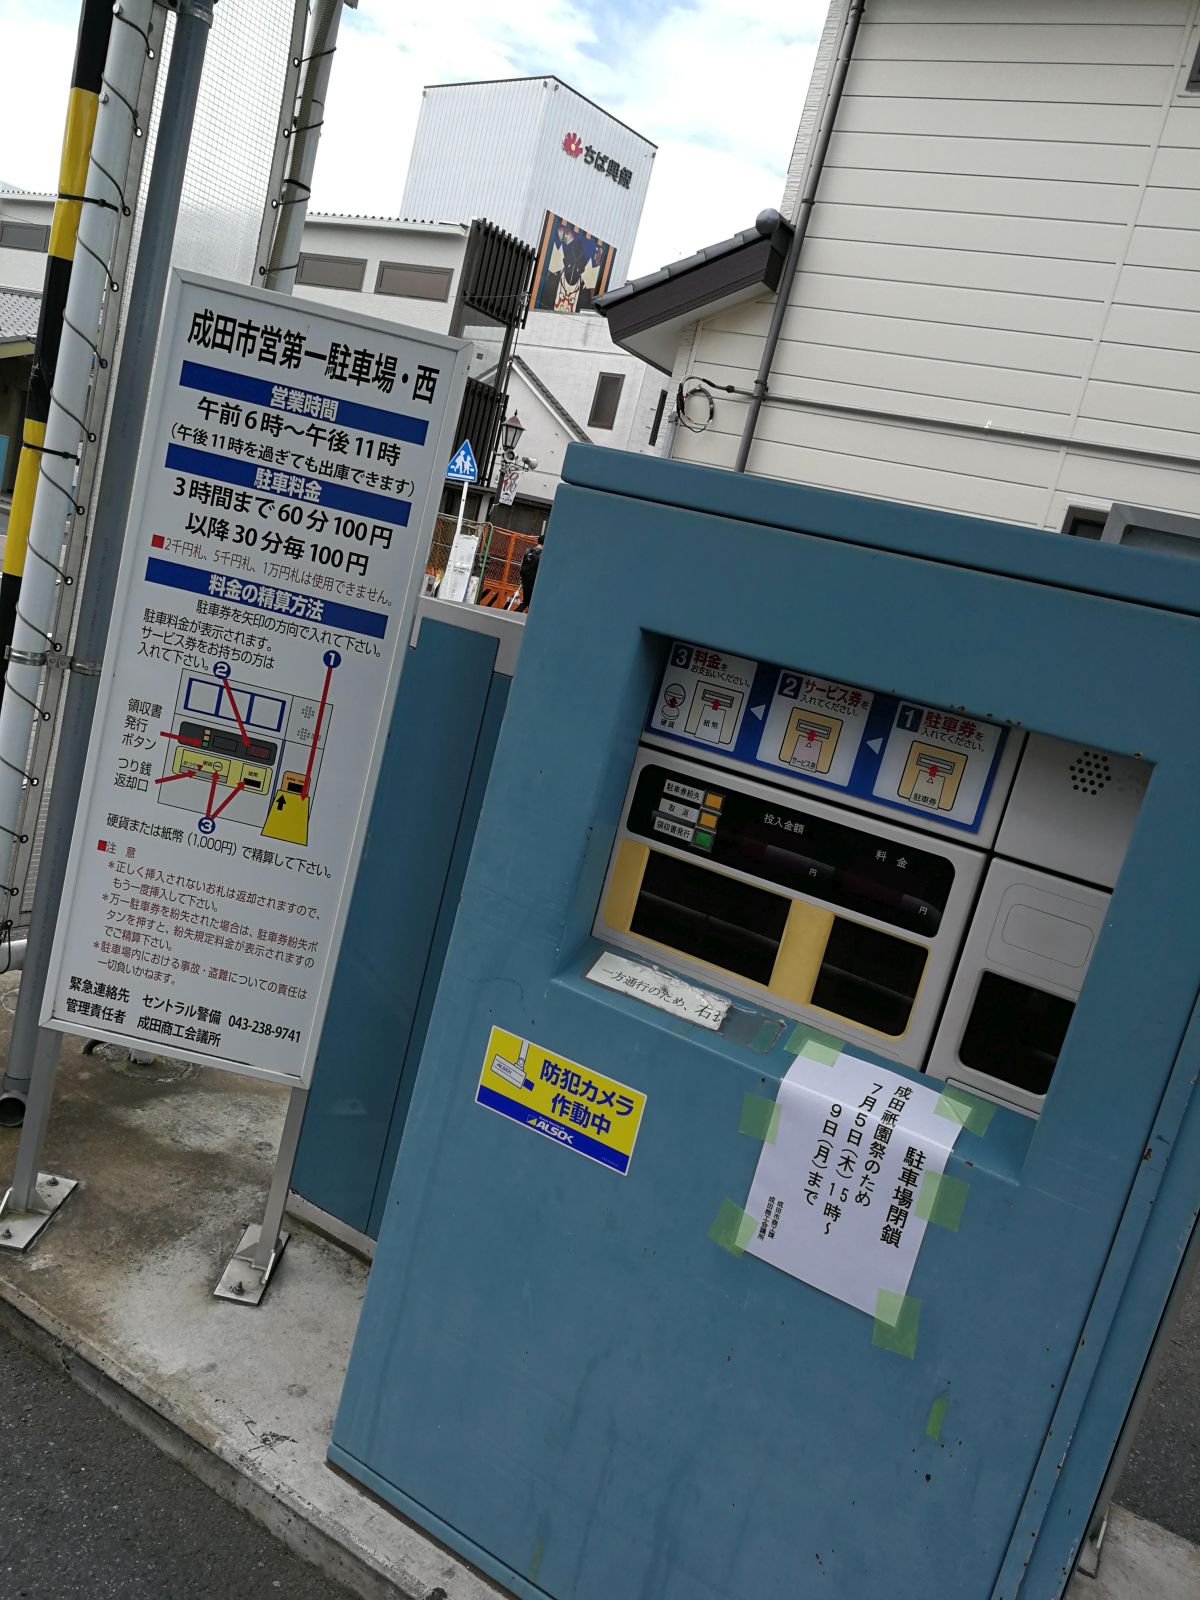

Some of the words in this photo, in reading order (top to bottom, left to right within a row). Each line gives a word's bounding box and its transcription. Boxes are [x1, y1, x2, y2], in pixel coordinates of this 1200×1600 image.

[583, 145, 633, 189] ちば興銀
[187, 308, 440, 404] 成田市営第一駐車場・西
[270, 385, 339, 422] 営業時間
[253, 467, 322, 504] 駐車料金
[208, 574, 325, 622] 料金の精算方法
[143, 608, 274, 652] 駐車料金が表示されます。
[195, 599, 382, 658] 駐車券を矢印の方向で入れて下さい。
[137, 643, 209, 671] 入れて下さい。
[141, 627, 275, 669] サービス券をお持ちの方は
[690, 664, 752, 689] お支払いください。
[128, 698, 163, 719] 領収書
[799, 694, 860, 717] 入れてください。
[124, 716, 148, 733] 発行
[121, 733, 156, 751] ボタン
[920, 728, 985, 753] 入れてください。
[118, 757, 152, 776] つり銭
[114, 773, 148, 793] 返却口
[912, 792, 937, 806] 駐車券
[656, 820, 691, 838] 領収書発行
[763, 813, 805, 835] 投入金額
[808, 867, 818, 877] 円
[113, 878, 219, 912] もう一度挿入して下さい。
[918, 905, 929, 916] 円
[104, 926, 174, 951] でご精算下さい。
[97, 959, 178, 986] 一切負いかねます。
[66, 997, 127, 1025] 管理責任者
[136, 1016, 222, 1047] 成田商工会議所
[69, 976, 131, 1004] 緊急連絡先
[142, 994, 223, 1026] セントラル警備
[228, 1013, 302, 1043] 043-238-9741
[540, 1059, 634, 1117] 防犯カメラ
[551, 1093, 611, 1136] 作動中
[537, 1120, 574, 1145] ALSOK
[854, 1085, 914, 1208] 成田祇園祭のため
[803, 1103, 842, 1206] 9日(月)まで
[880, 1146, 927, 1249] 駐車場閉鎖
